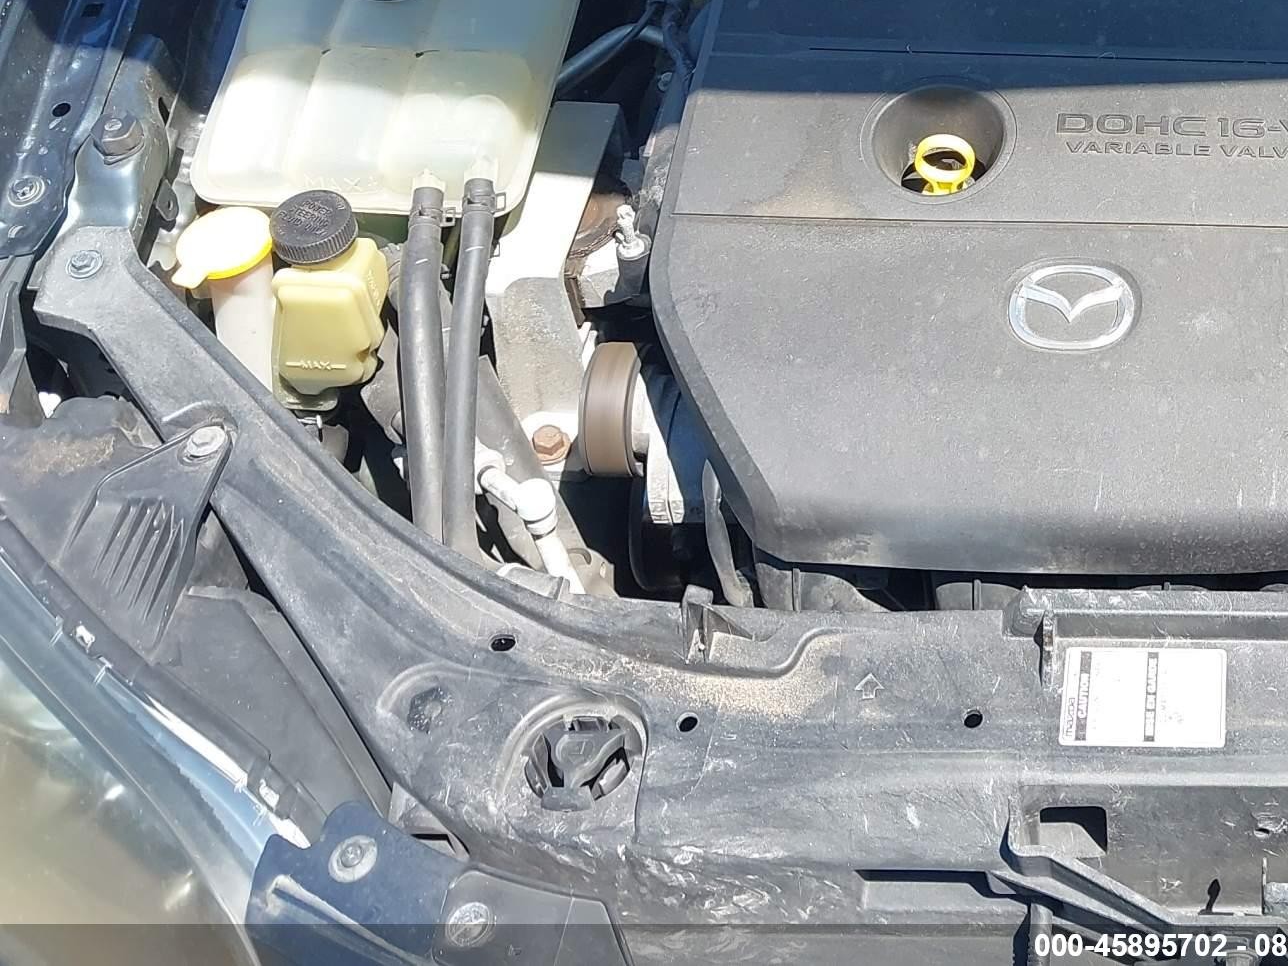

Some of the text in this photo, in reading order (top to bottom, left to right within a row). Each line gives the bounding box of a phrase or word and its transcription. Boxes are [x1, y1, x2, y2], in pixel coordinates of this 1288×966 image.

[1056, 112, 1207, 137] DOHC
[1066, 140, 1212, 157] VARIABLE
[300, 360, 332, 371] MAX
[1077, 672, 1090, 719] CAUTION
[1064, 697, 1076, 738] mazda
